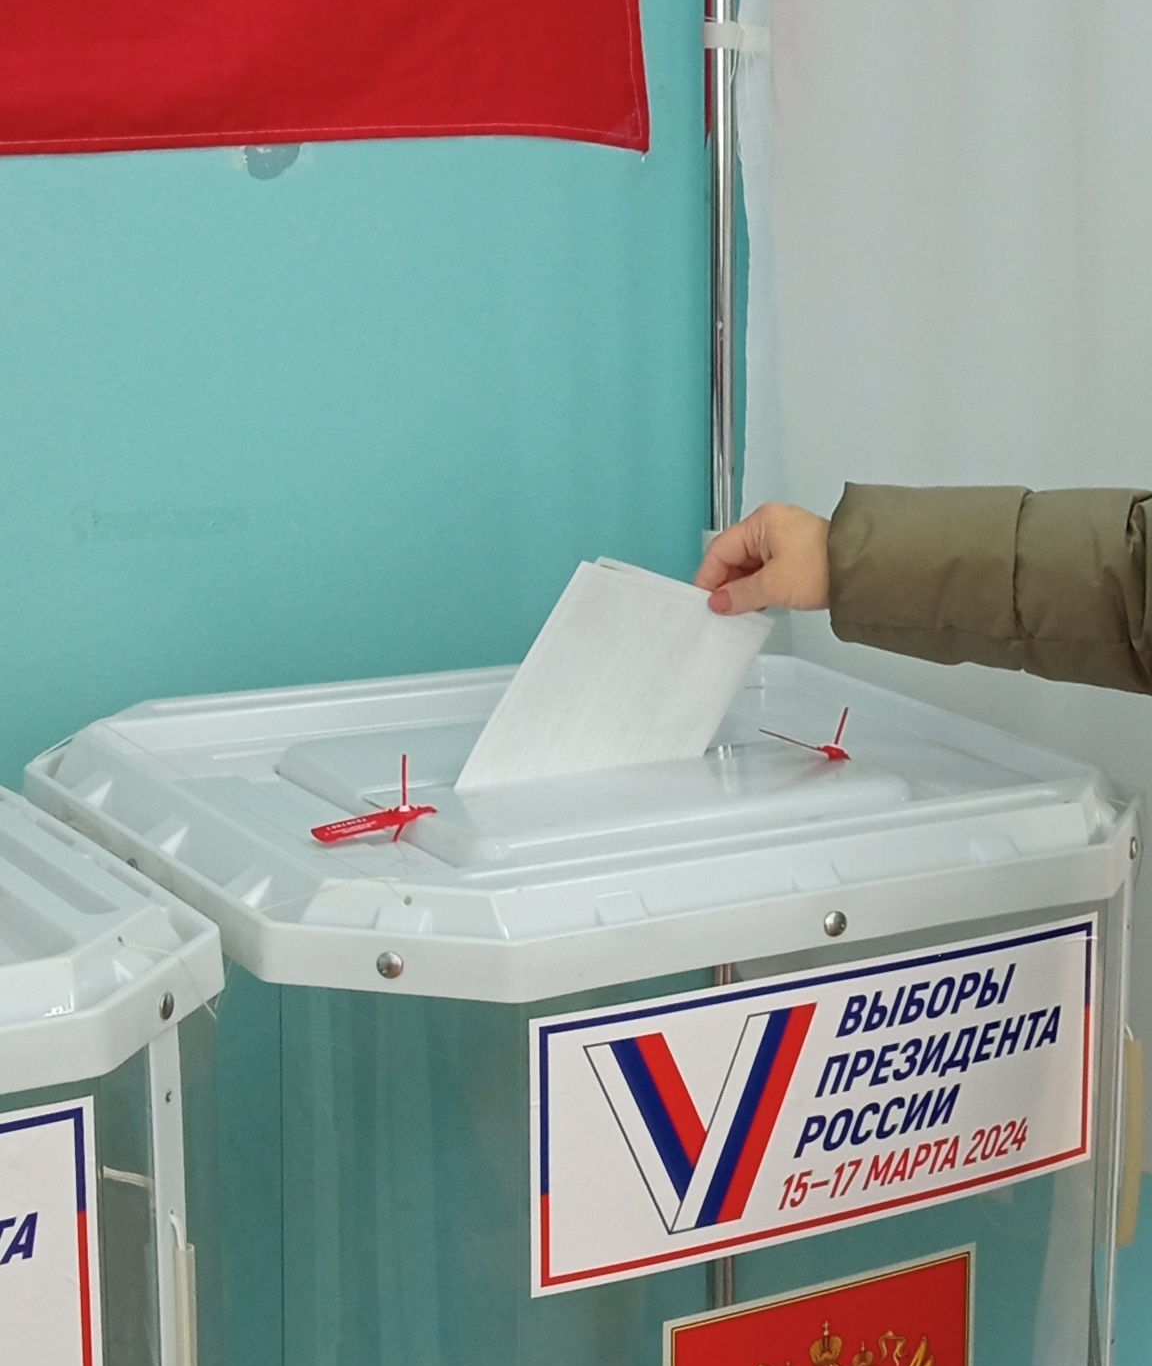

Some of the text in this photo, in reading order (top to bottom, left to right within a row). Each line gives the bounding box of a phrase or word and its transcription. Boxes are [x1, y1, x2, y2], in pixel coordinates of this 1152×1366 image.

[836, 962, 1017, 1038] ВЫБОРЫ
[815, 1005, 1062, 1098] ПРЕЗИДЕНТА
[794, 1084, 961, 1159] РОССИИ
[864, 1136, 960, 1189] МАРТА
[962, 1116, 1029, 1167] 2024
